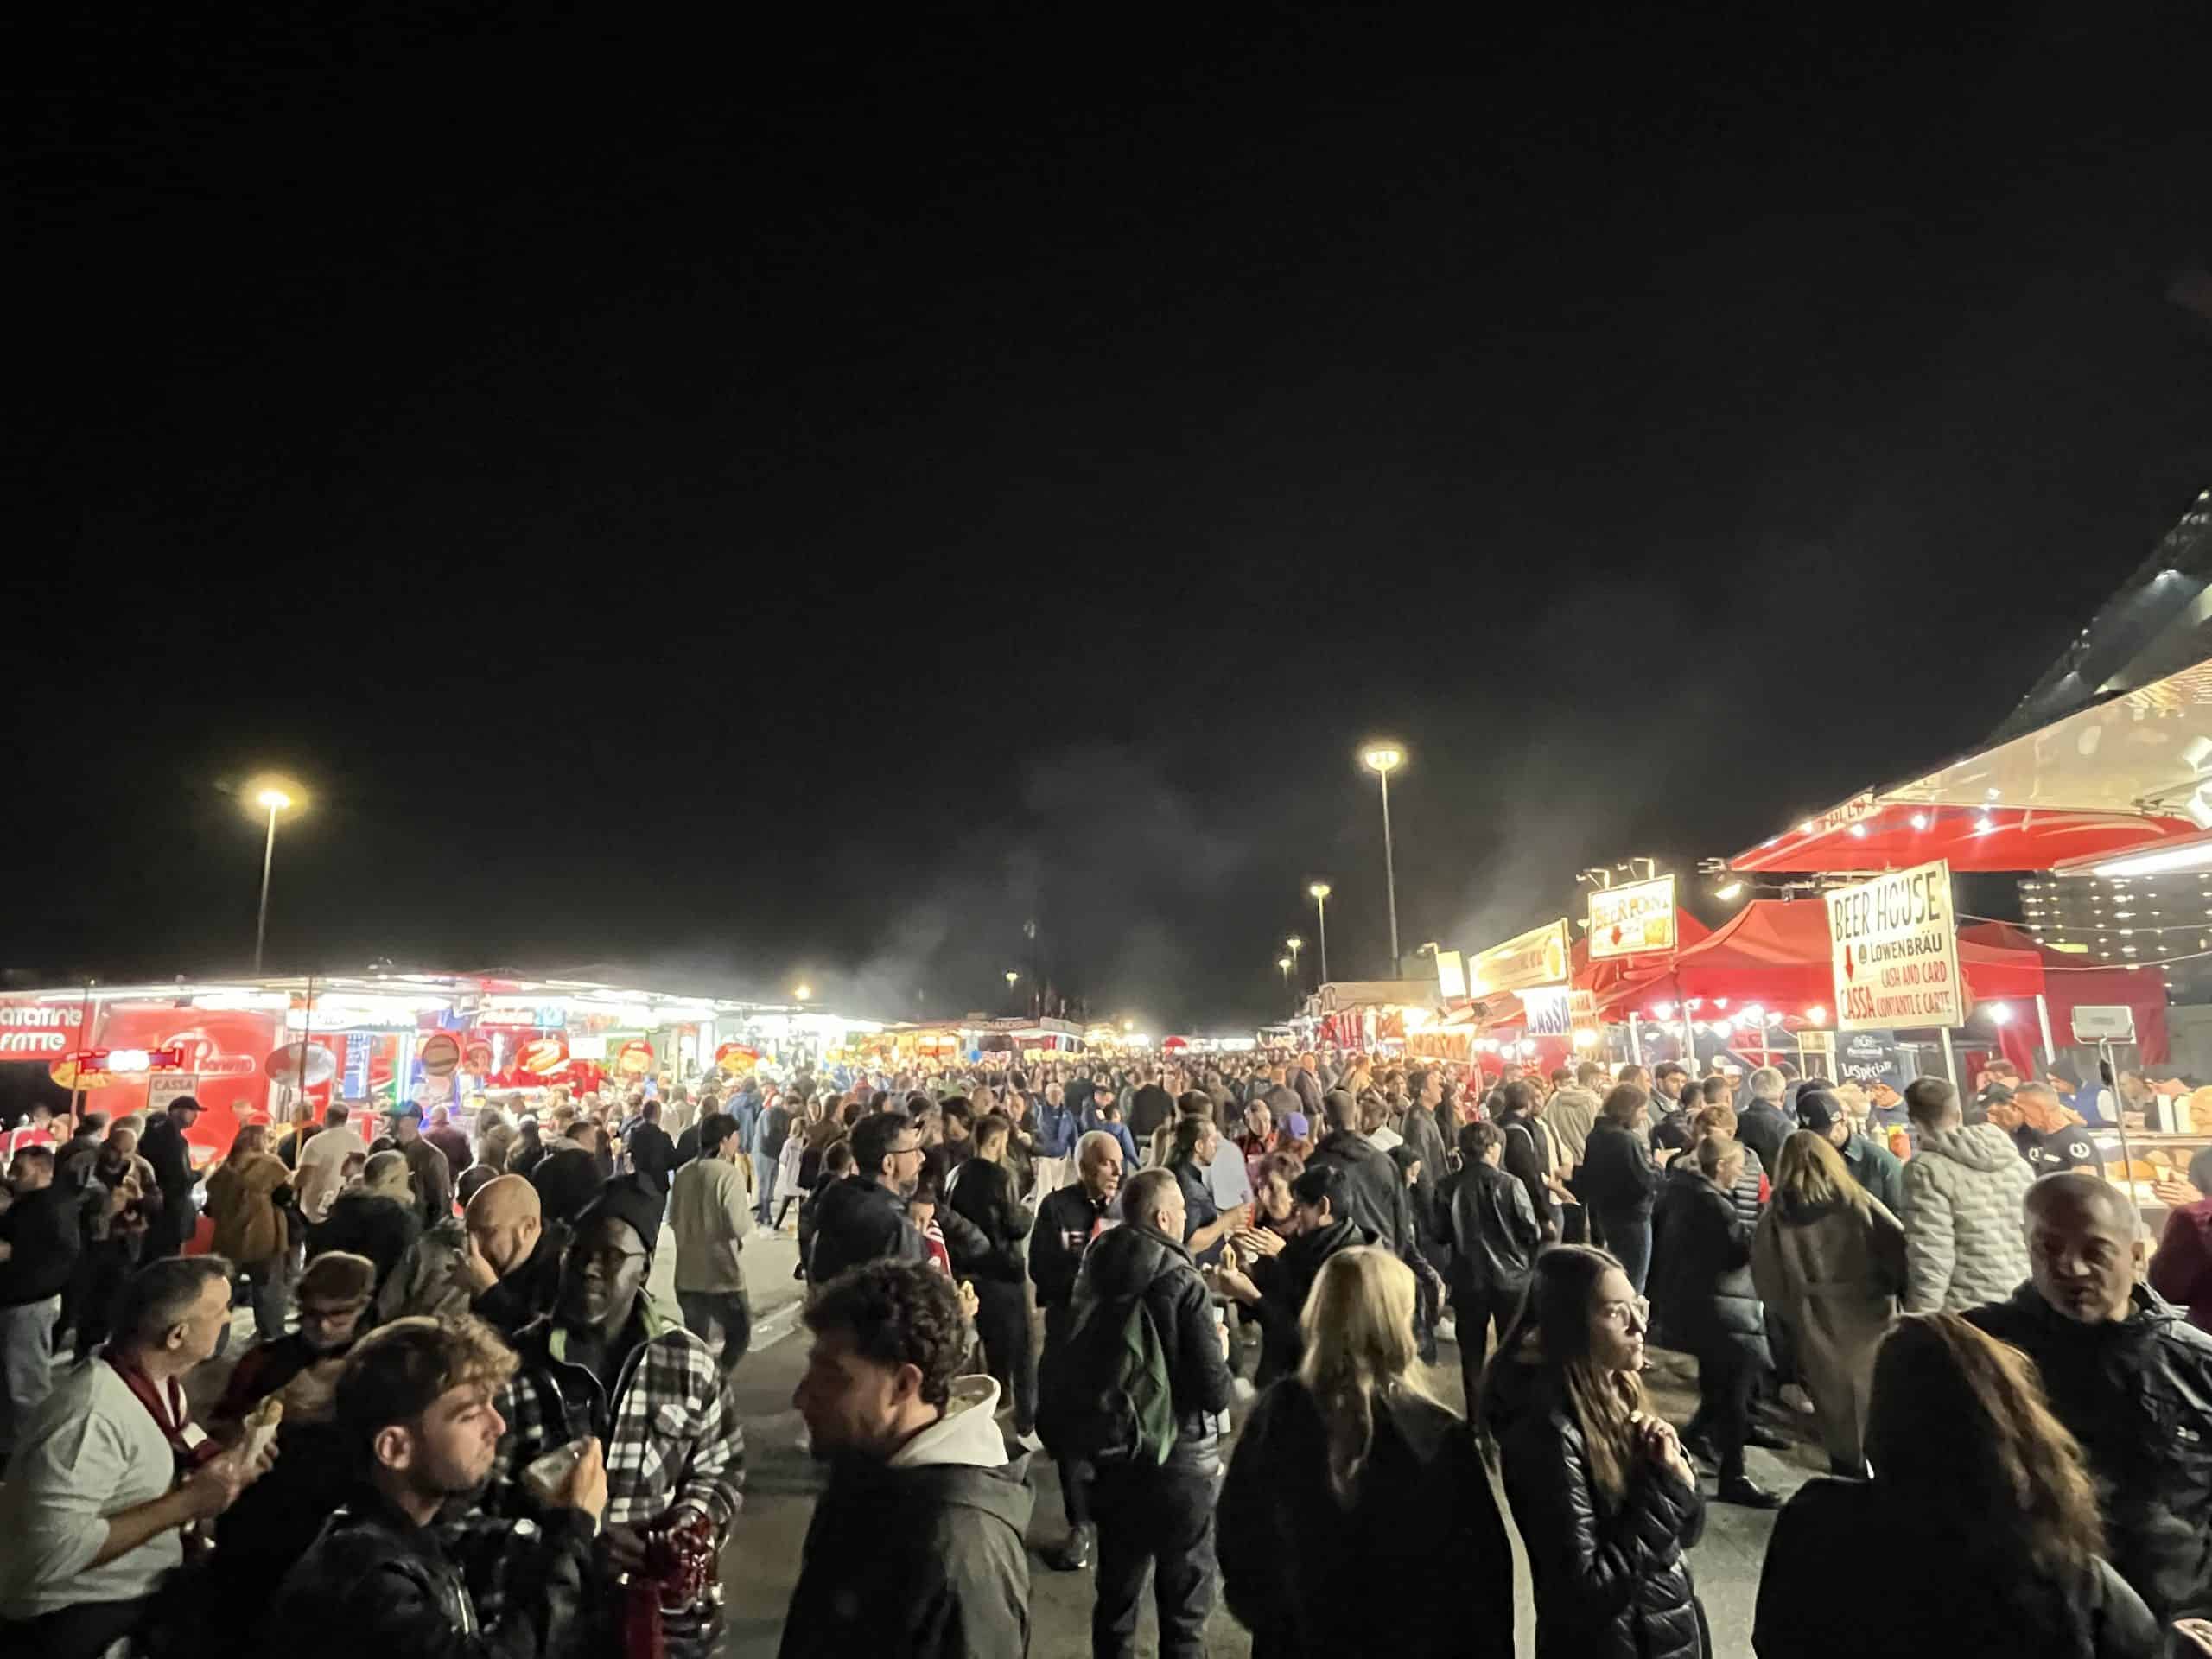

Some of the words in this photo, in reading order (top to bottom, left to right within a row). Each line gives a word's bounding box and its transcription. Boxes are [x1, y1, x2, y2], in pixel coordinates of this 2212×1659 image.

[1834, 891, 1871, 943] BEER
[1877, 870, 1941, 931] HOUSE
[1881, 967, 1901, 988] CASH
[1902, 963, 1920, 987] AND
[1922, 960, 1948, 984] CARD
[1841, 986, 1877, 1020] CASSA
[154, 1079, 194, 1091] CASSA
